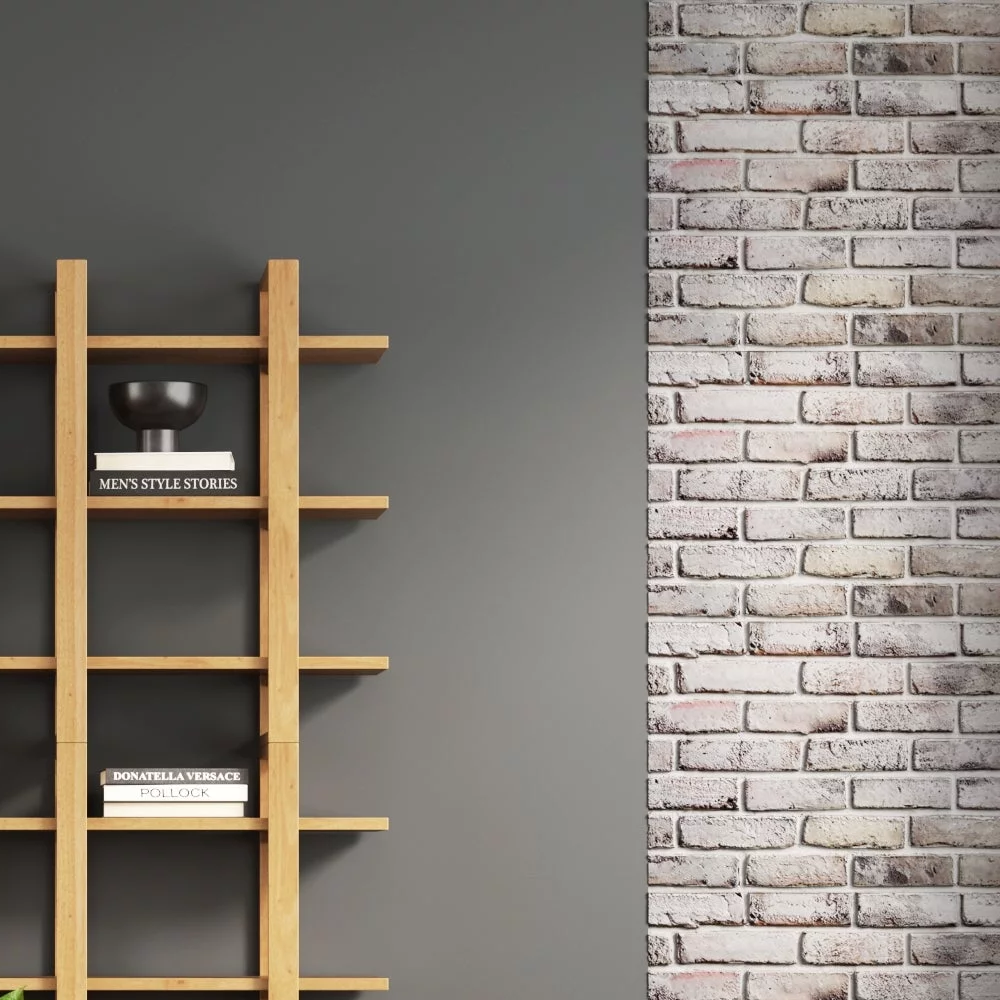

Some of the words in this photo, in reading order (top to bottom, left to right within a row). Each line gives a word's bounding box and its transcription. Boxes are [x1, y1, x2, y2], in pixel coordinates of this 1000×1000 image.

[141, 478, 181, 490] STYLE
[183, 478, 238, 490] STORIES
[113, 771, 184, 781] DONATELLA
[186, 771, 241, 781] VERSACE
[140, 788, 210, 798] POLLOCK
